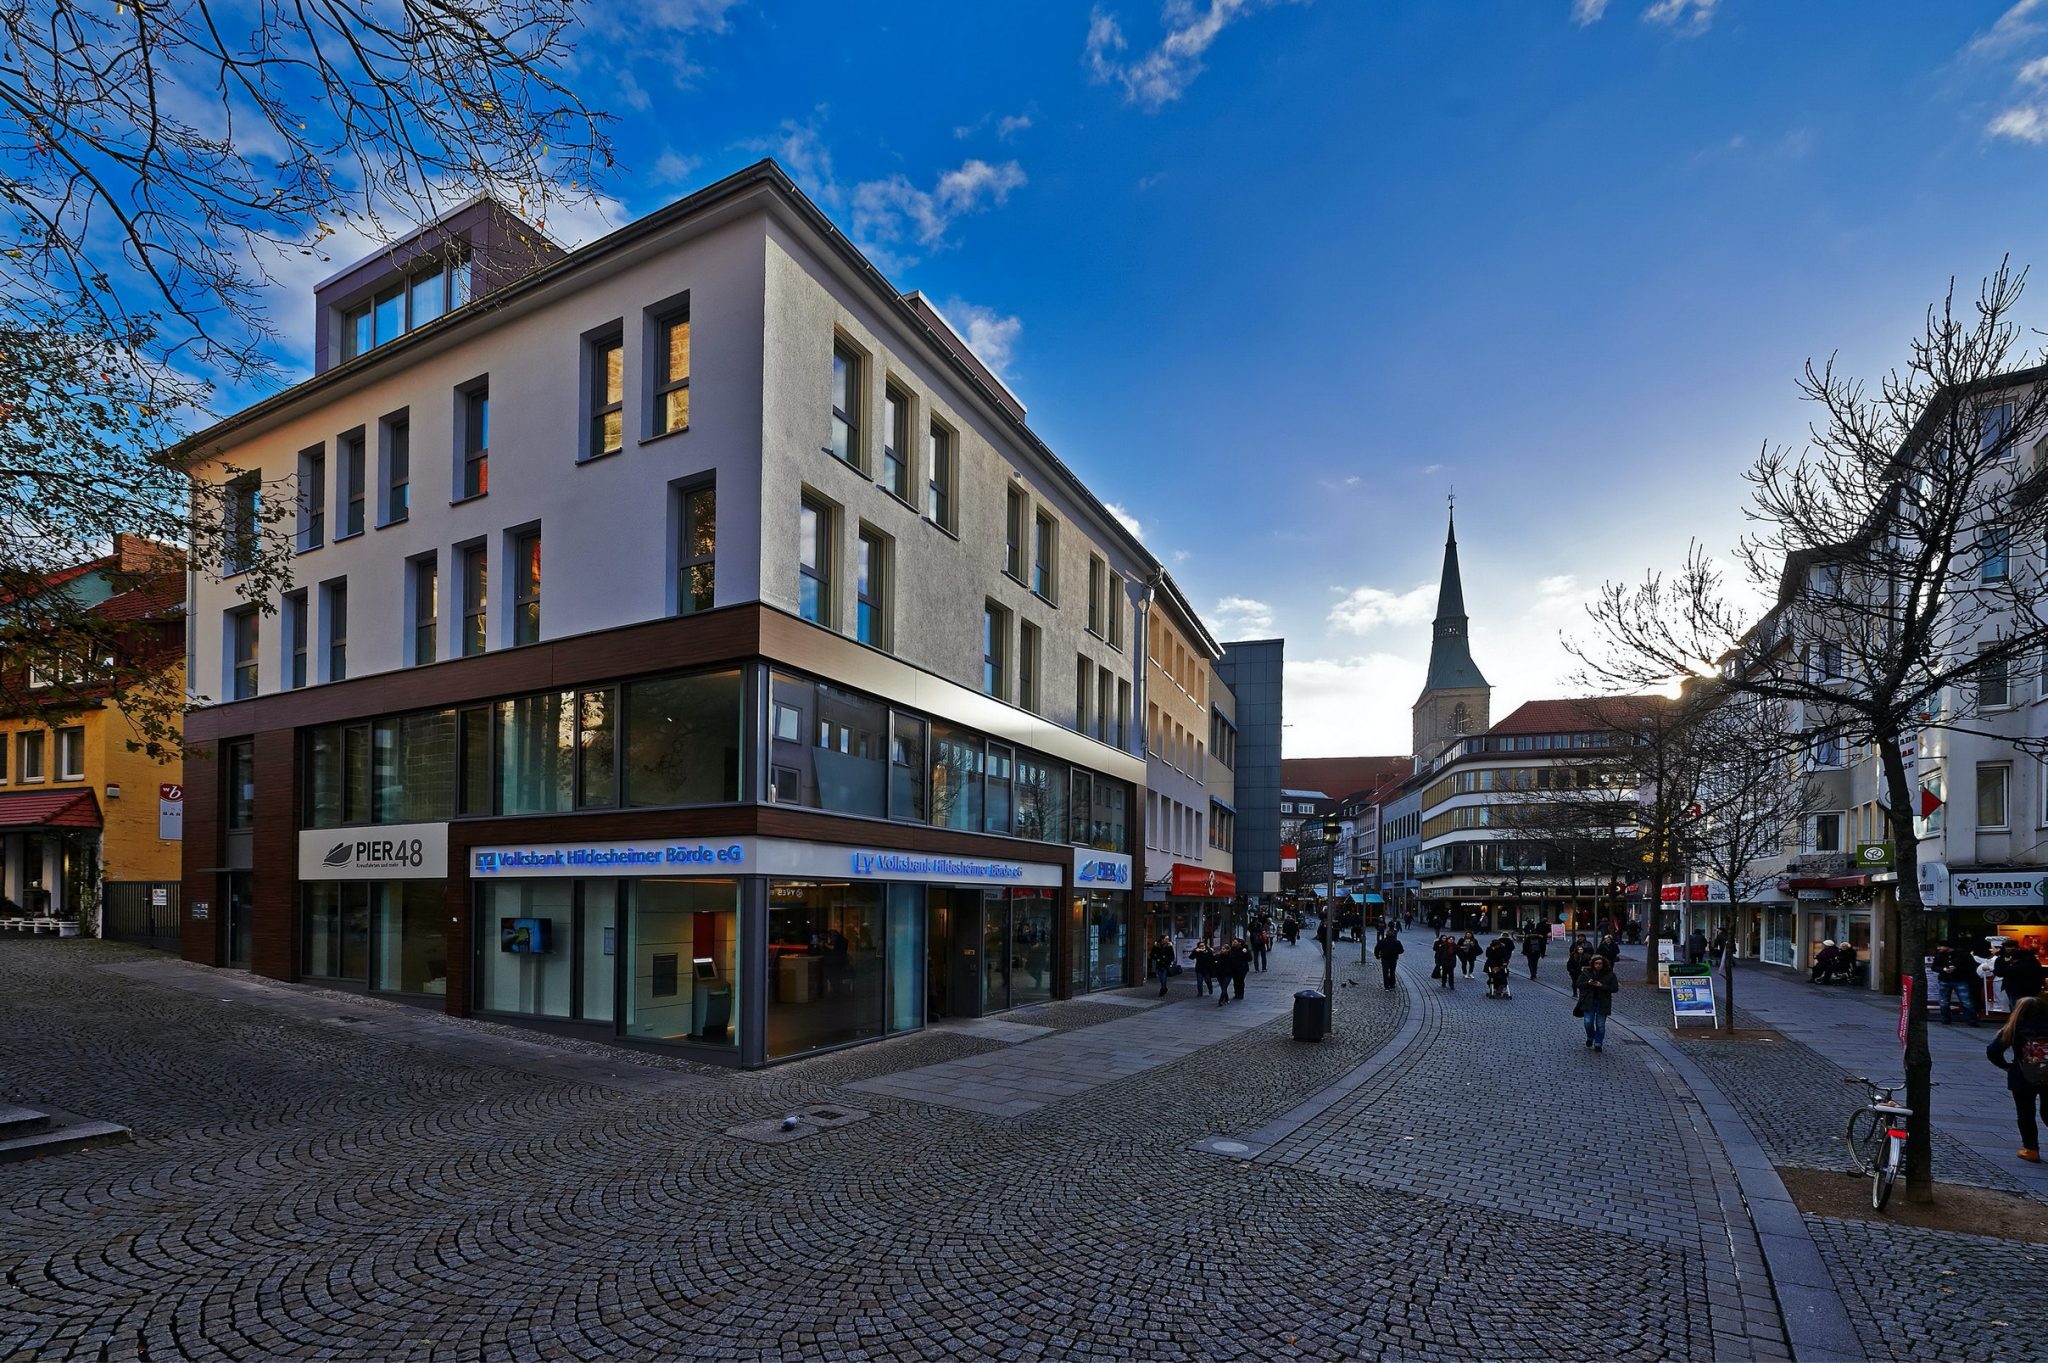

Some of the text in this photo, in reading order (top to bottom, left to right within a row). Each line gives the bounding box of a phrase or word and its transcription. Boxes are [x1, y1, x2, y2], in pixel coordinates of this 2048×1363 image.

[498, 845, 741, 866] Volksbank Hildesheimer Börde eG
[877, 854, 932, 873] Volksbank
[933, 858, 987, 876] Hildesheimer
[1976, 881, 2032, 889] DORADO
[1978, 889, 2029, 897] HOUSE
